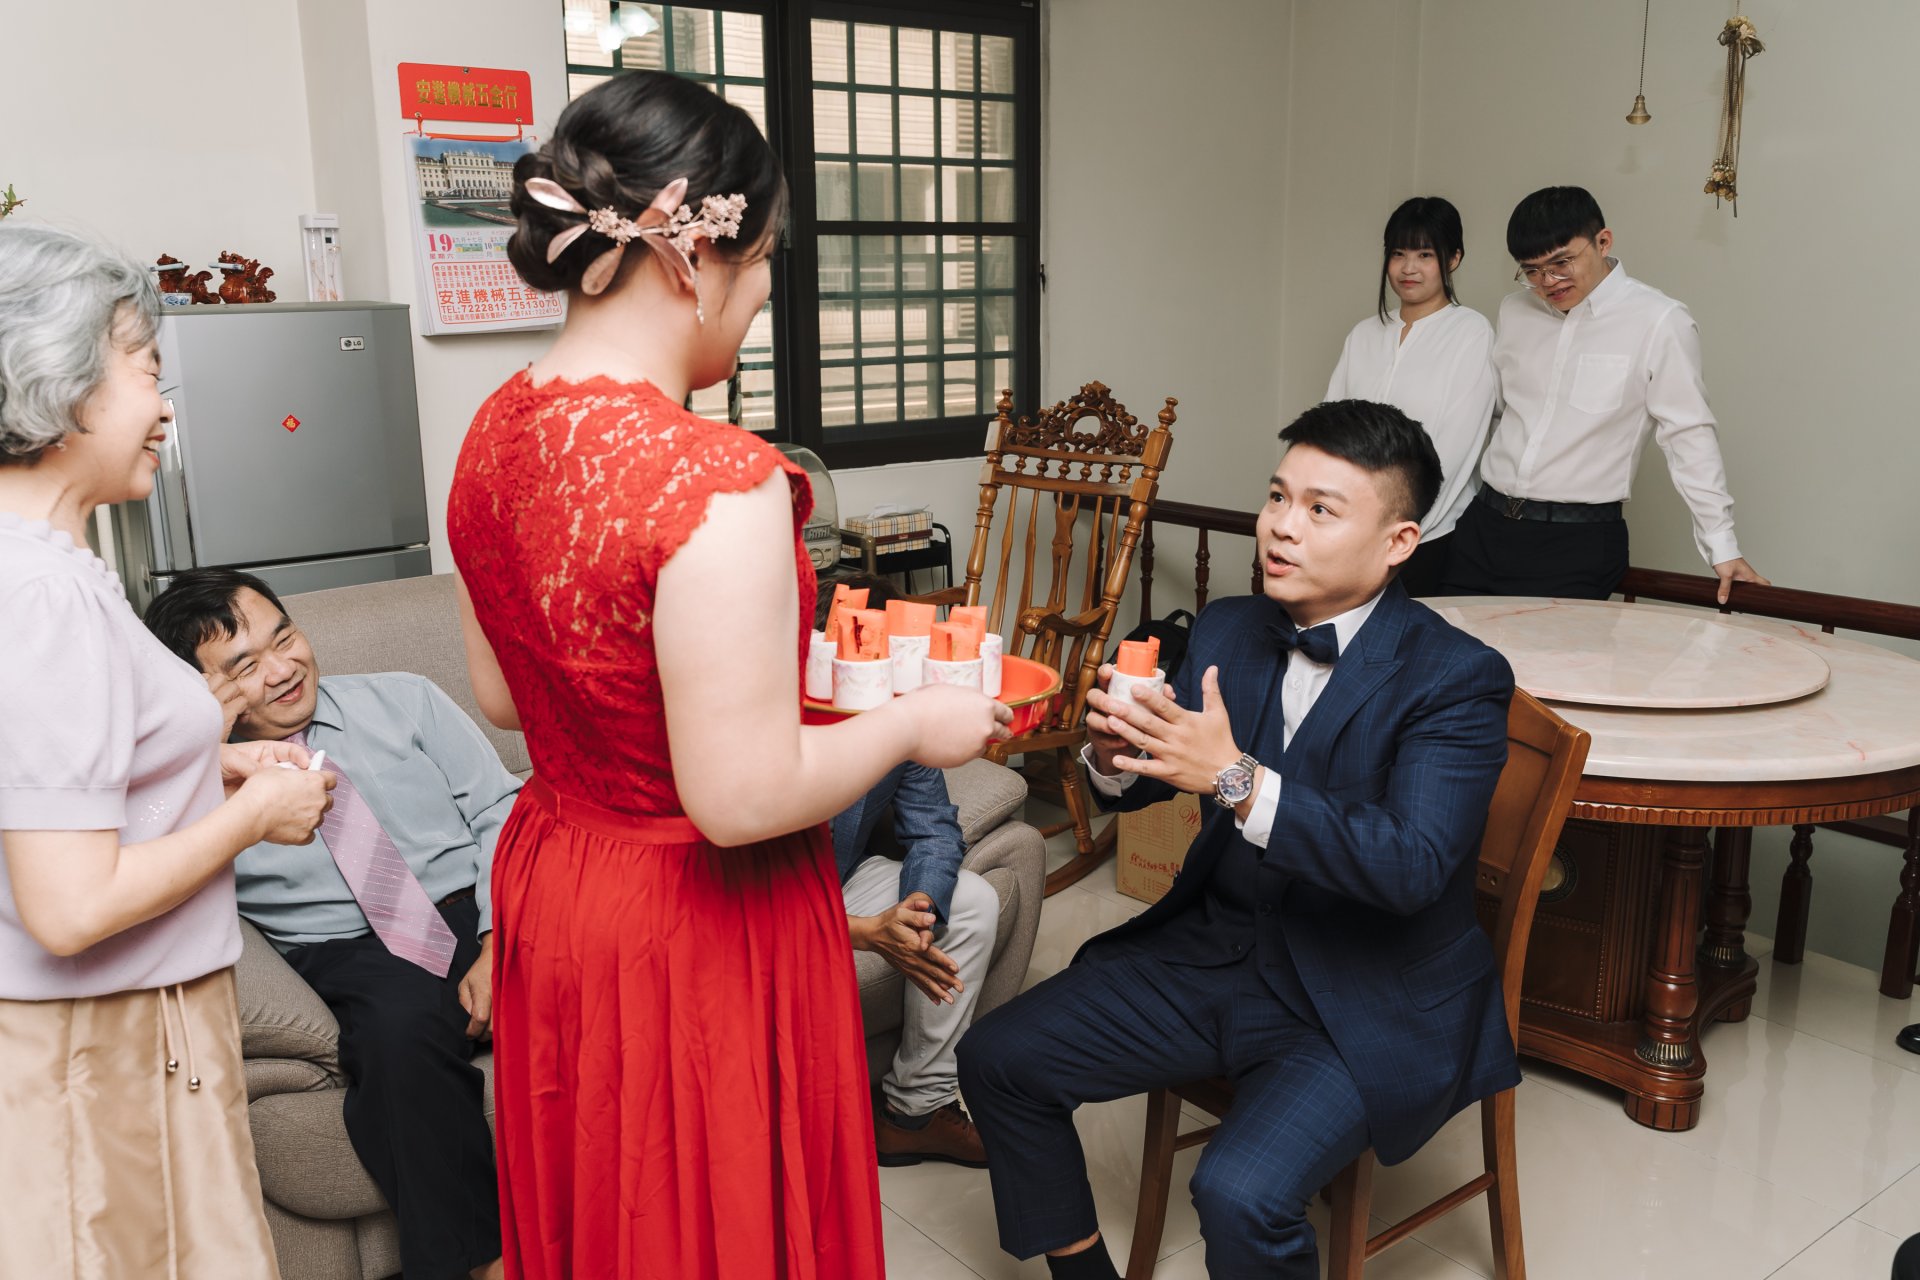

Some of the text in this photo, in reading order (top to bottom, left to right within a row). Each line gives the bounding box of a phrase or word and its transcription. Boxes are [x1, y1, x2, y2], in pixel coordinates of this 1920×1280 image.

[415, 79, 519, 109] 安進機械五金行
[428, 233, 453, 252] 19
